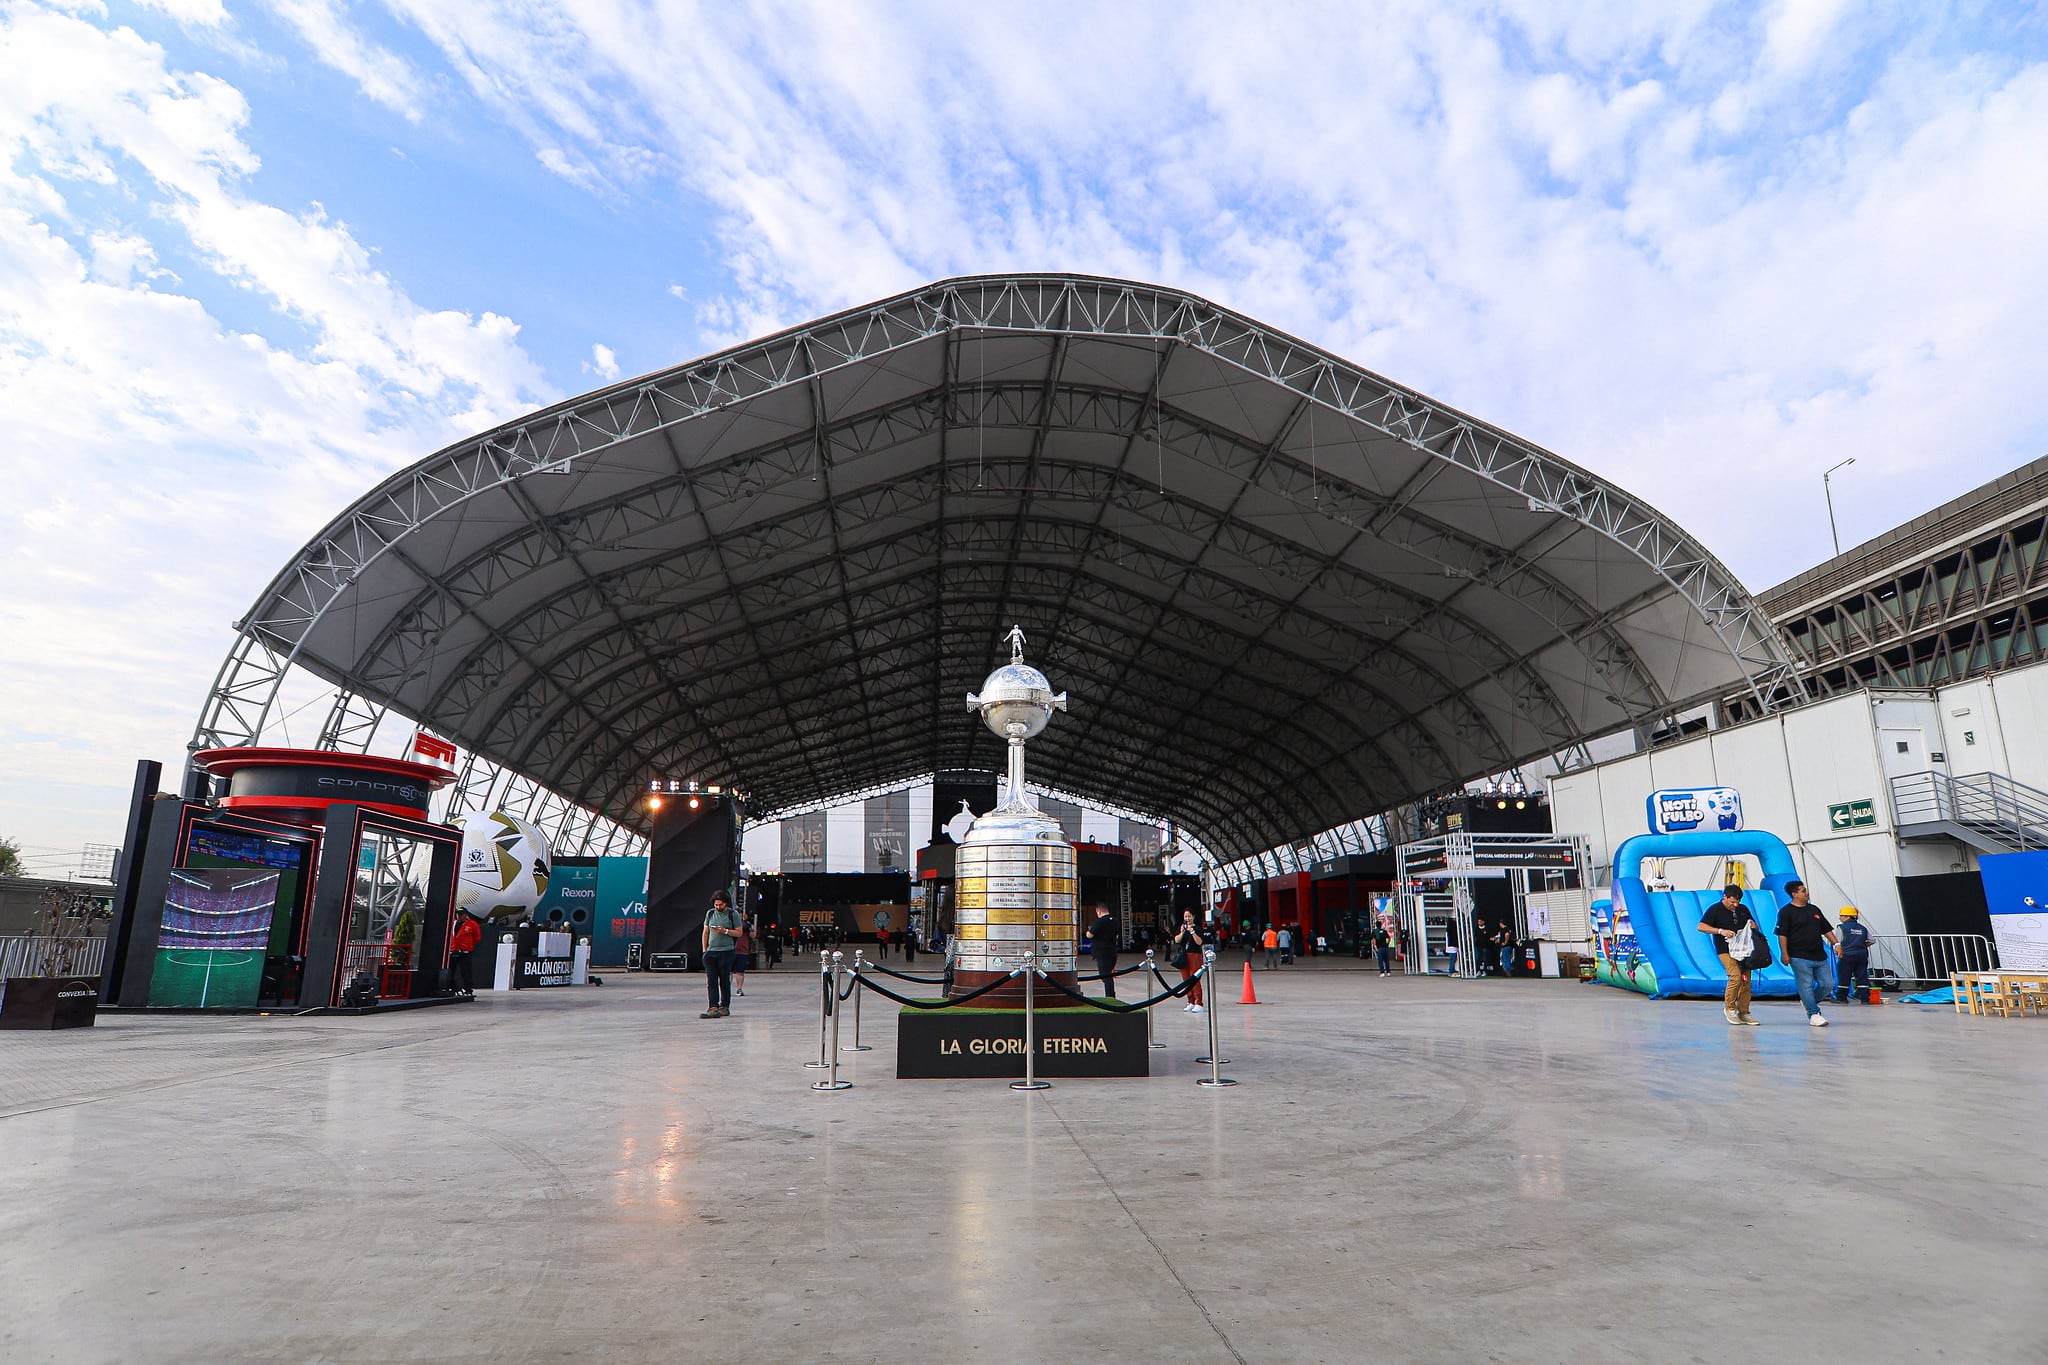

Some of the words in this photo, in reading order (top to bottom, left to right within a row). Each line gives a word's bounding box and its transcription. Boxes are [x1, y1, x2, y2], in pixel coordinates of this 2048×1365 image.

[414, 732, 457, 765] ESPN
[1662, 810, 1704, 823] FULBO
[1852, 807, 1873, 818] SALIDA
[634, 903, 648, 913] Re
[524, 959, 553, 975] BALÓN
[540, 976, 563, 985] CONMEBOL
[57, 990, 86, 998] CONVEXIA
[940, 1039, 962, 1054] LA
[1043, 1038, 1108, 1054] ETERNA
